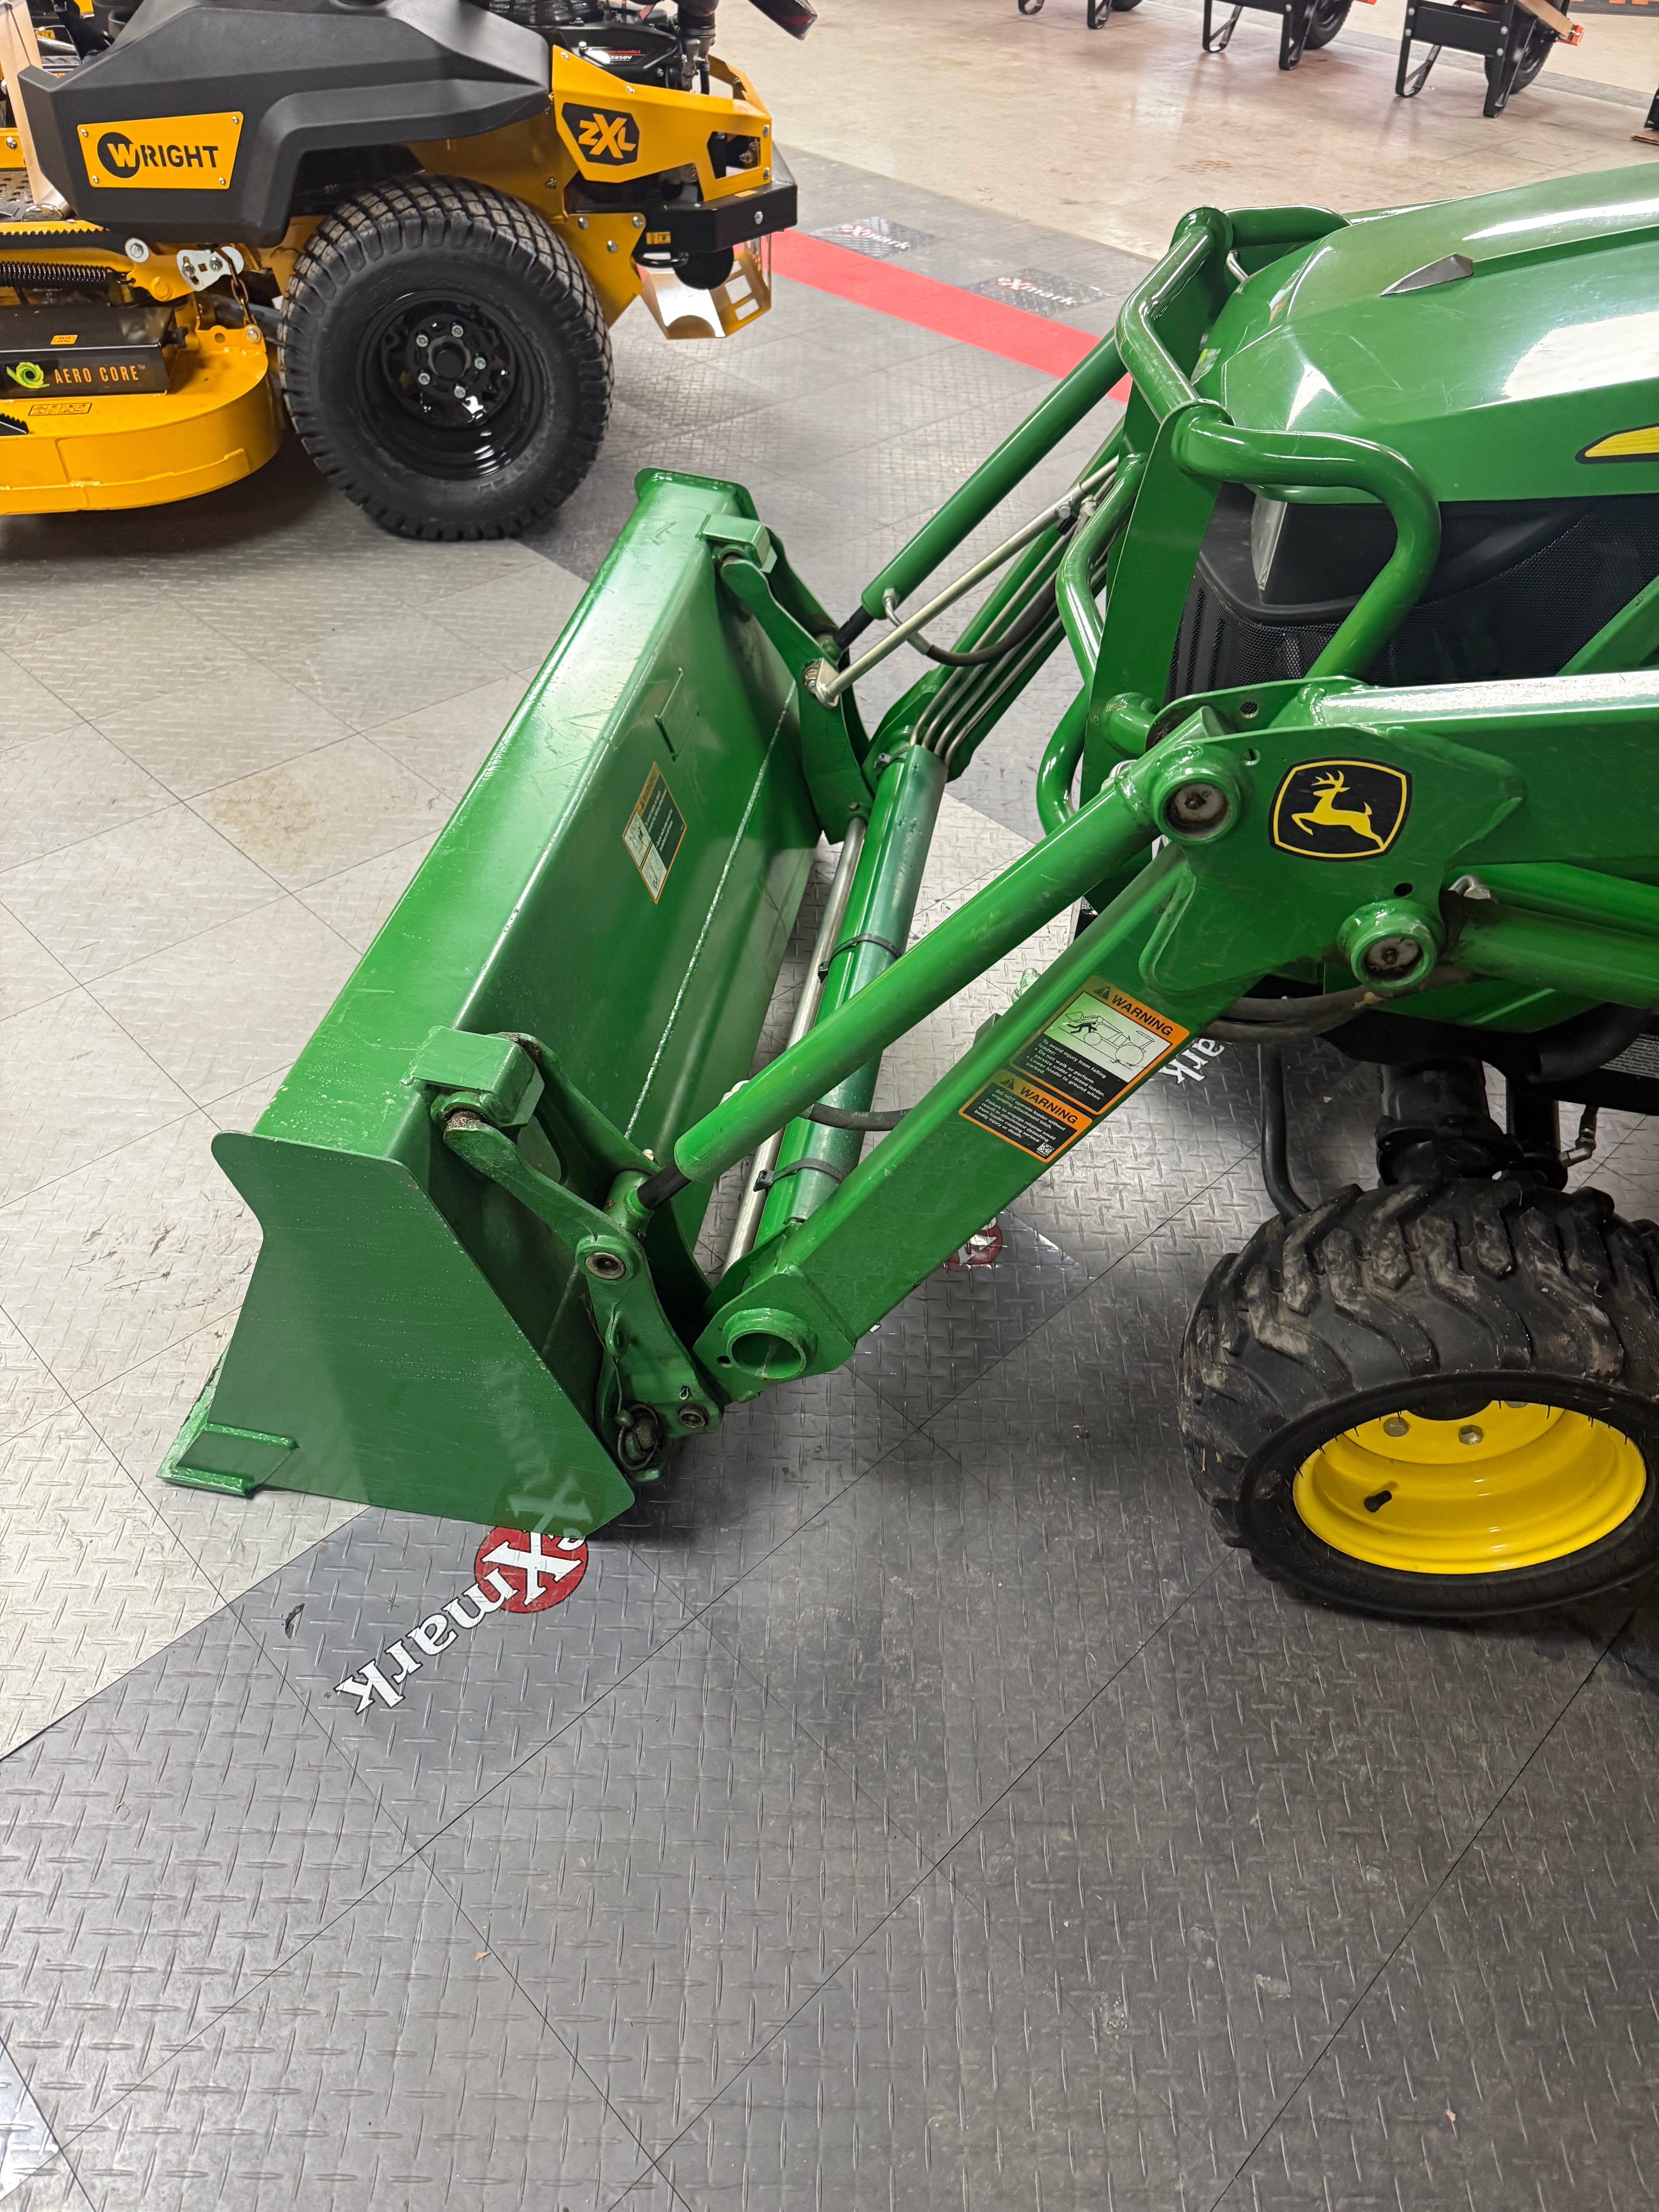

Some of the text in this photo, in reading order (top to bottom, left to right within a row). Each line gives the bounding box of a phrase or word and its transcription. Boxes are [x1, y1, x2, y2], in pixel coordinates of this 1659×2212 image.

[104, 142, 218, 168] WRIGHT
[54, 368, 92, 384] AERO
[1112, 995, 1173, 1036] WARNING
[1033, 1054, 1053, 1066] service
[1052, 1065, 1068, 1075] under
[1071, 1075, 1089, 1087] raised
[1048, 1043, 1064, 1053] avoid
[1062, 1051, 1079, 1062] injury
[1077, 1060, 1092, 1069] from
[1089, 1067, 1108, 1079] falling
[1054, 1060, 1068, 1068] walk
[1072, 1070, 1095, 1084] perform
[1029, 1058, 1046, 1068] Lower
[1045, 1066, 1063, 1078] loader
[1067, 1080, 1087, 1092] ground
[1085, 1090, 1101, 1100] when
[1020, 1087, 1078, 1124] WARNING
